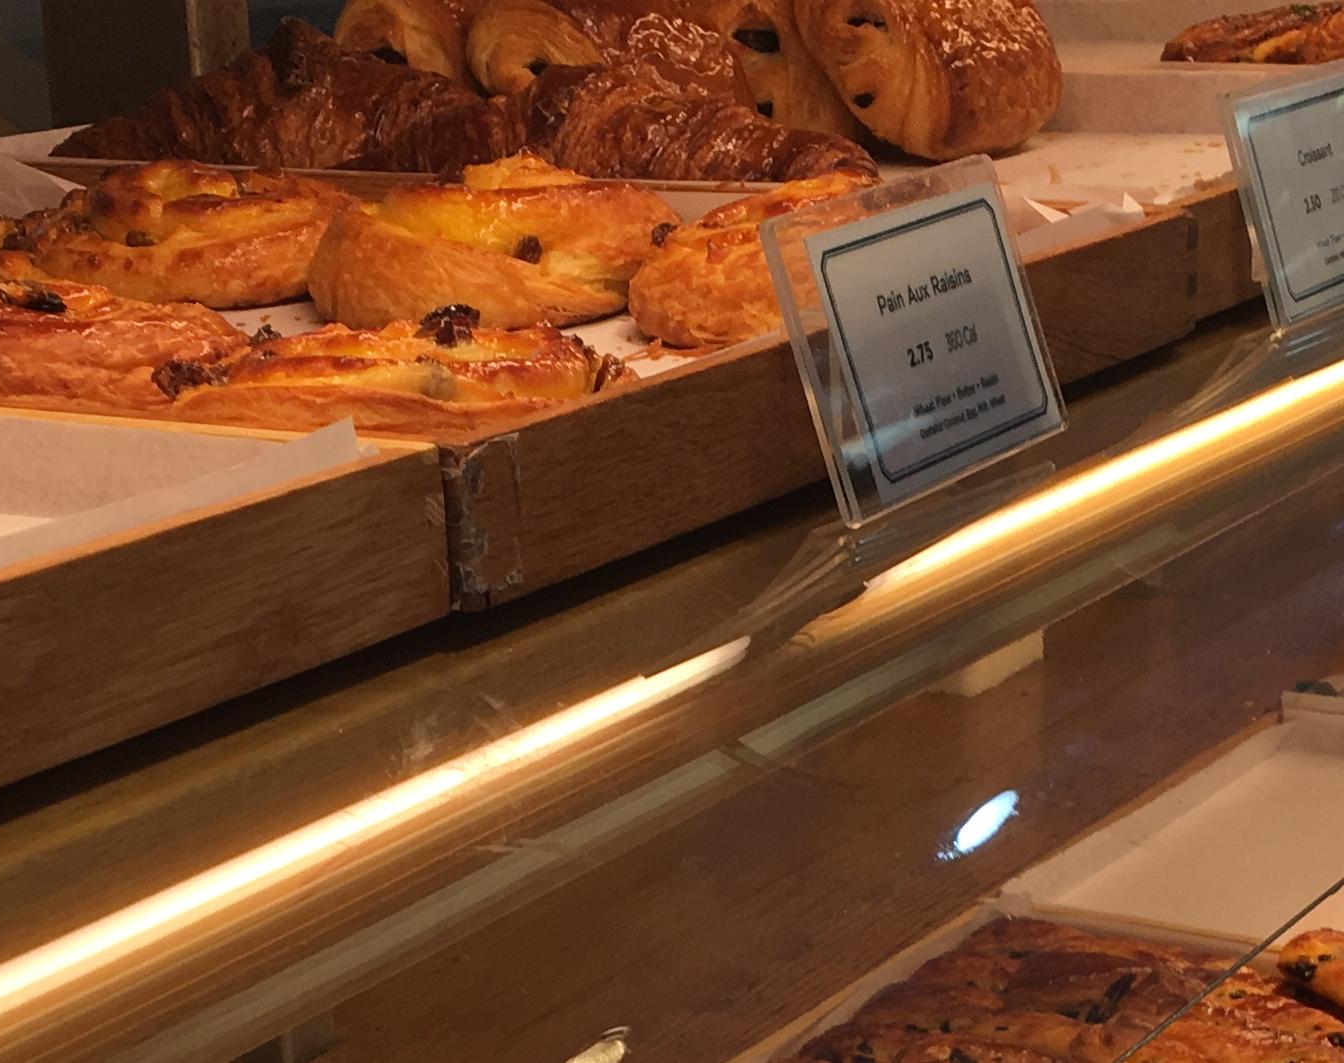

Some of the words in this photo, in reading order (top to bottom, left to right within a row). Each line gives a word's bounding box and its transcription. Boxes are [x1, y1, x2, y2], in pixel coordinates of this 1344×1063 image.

[1298, 142, 1334, 167] Croissant
[876, 290, 905, 316] Pain
[907, 283, 931, 305] Aux
[930, 267, 972, 296] Raisins
[906, 341, 934, 368] 2.75
